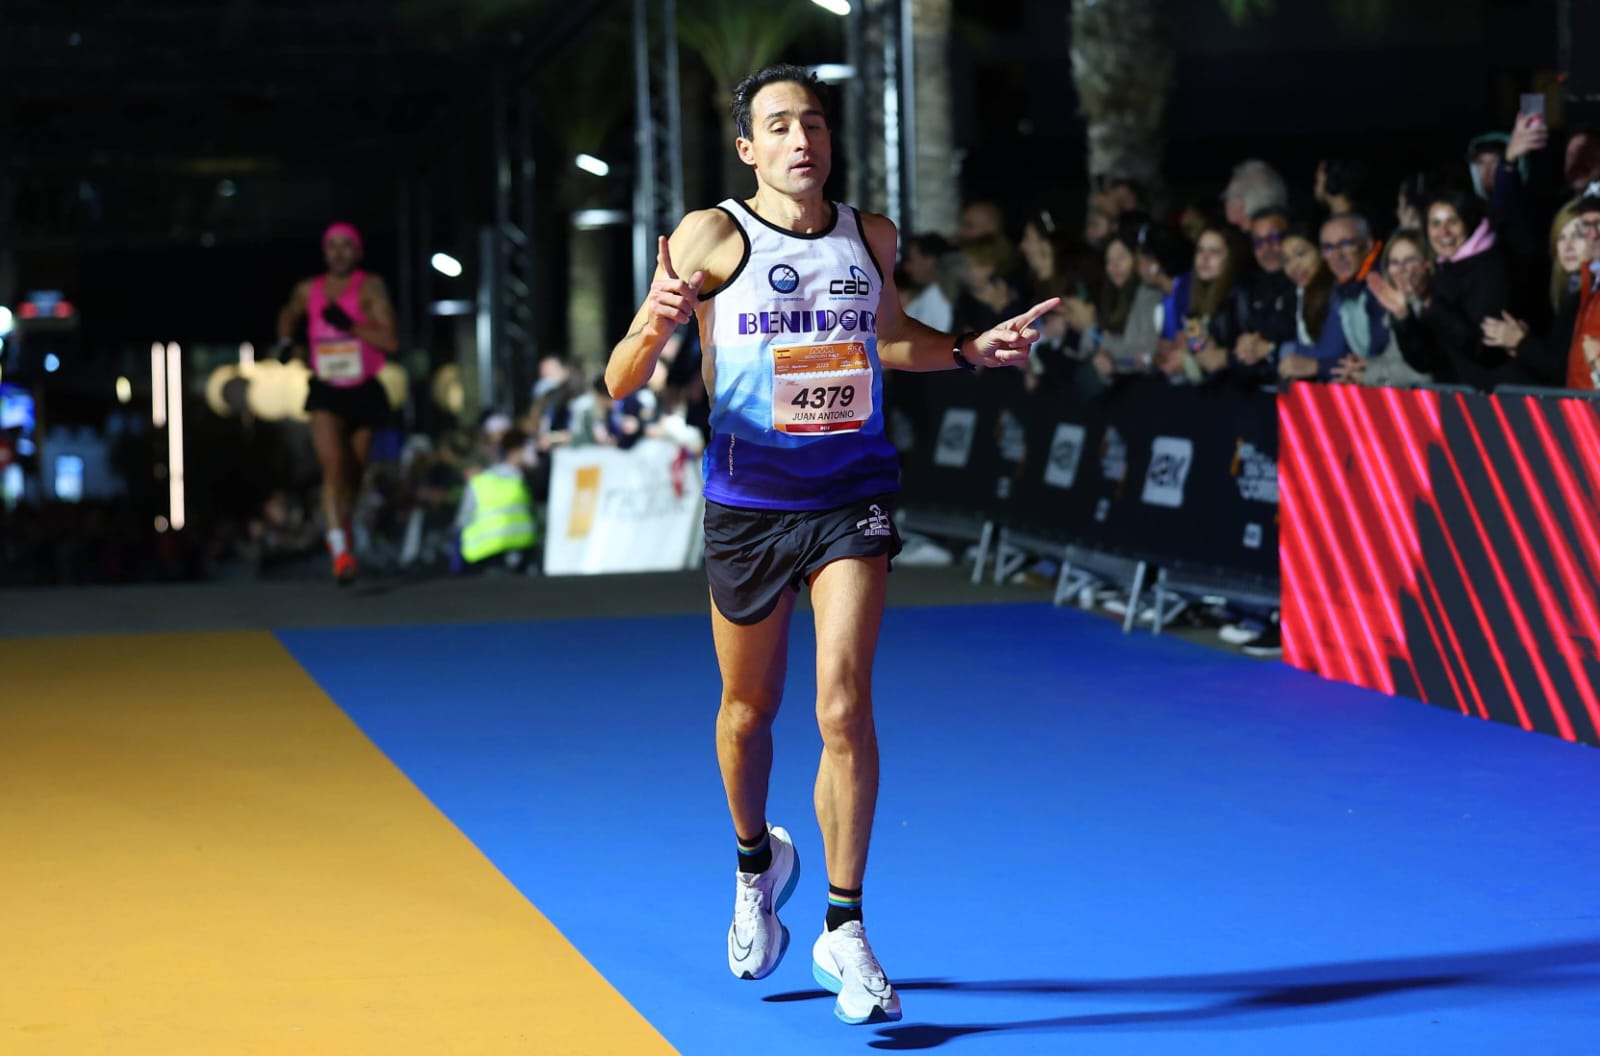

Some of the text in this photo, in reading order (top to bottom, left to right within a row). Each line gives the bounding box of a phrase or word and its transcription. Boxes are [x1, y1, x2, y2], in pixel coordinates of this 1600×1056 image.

[829, 276, 869, 295] cab
[791, 385, 855, 409] 4379
[792, 410, 854, 421] JUAN ANTONIO
